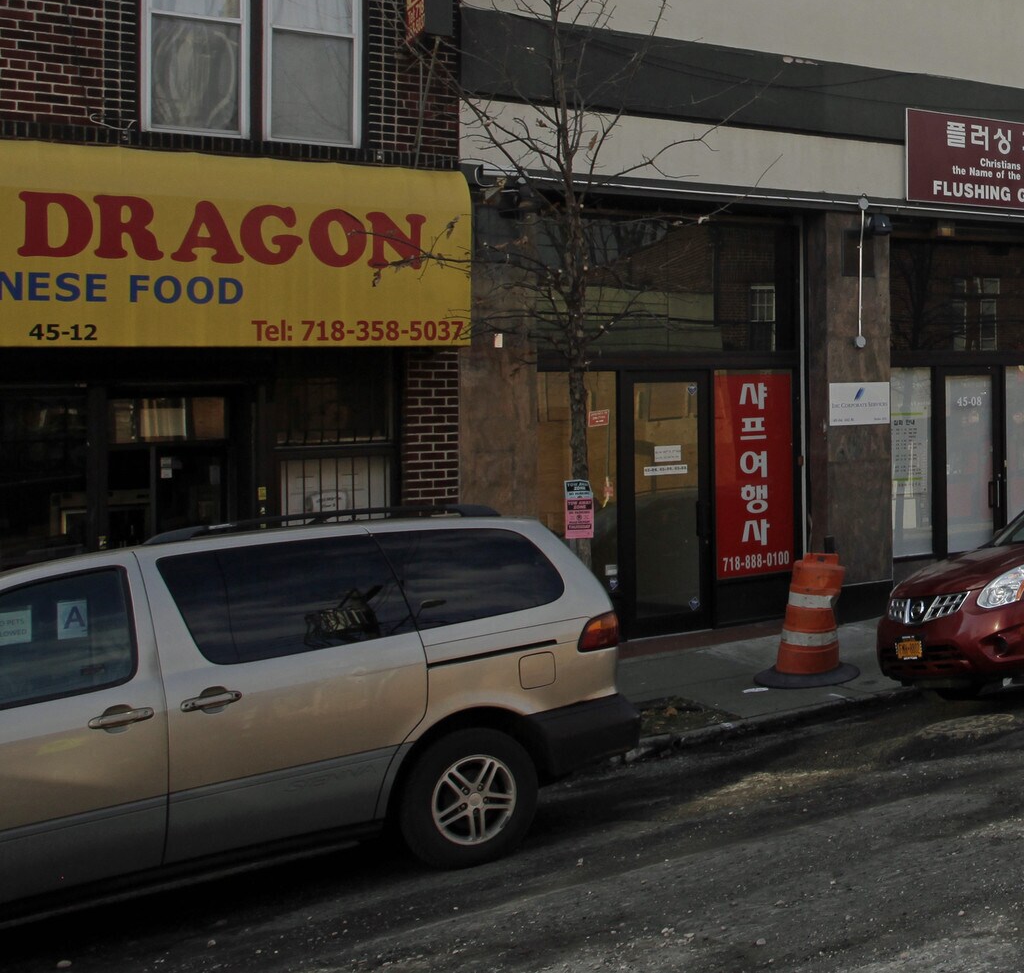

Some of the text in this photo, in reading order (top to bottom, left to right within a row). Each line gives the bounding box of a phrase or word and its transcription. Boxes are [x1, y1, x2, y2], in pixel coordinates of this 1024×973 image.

[946, 120, 1012, 155] 플러싱
[952, 165, 966, 175] the
[969, 167, 993, 178] Name
[996, 170, 1005, 179] of
[1008, 170, 1021, 180] the
[980, 158, 1021, 171] Christians
[933, 180, 1011, 201] FLUSHING
[17, 190, 427, 270] DRAGON
[129, 274, 244, 305] FOOD
[29, 324, 98, 341] 45-12
[251, 320, 464, 342] Tel: 718-358-5037
[957, 396, 982, 407] 45-08
[722, 550, 790, 573] 718-888-0100
[6, 618, 25, 626] PETS
[63, 605, 86, 630] A
